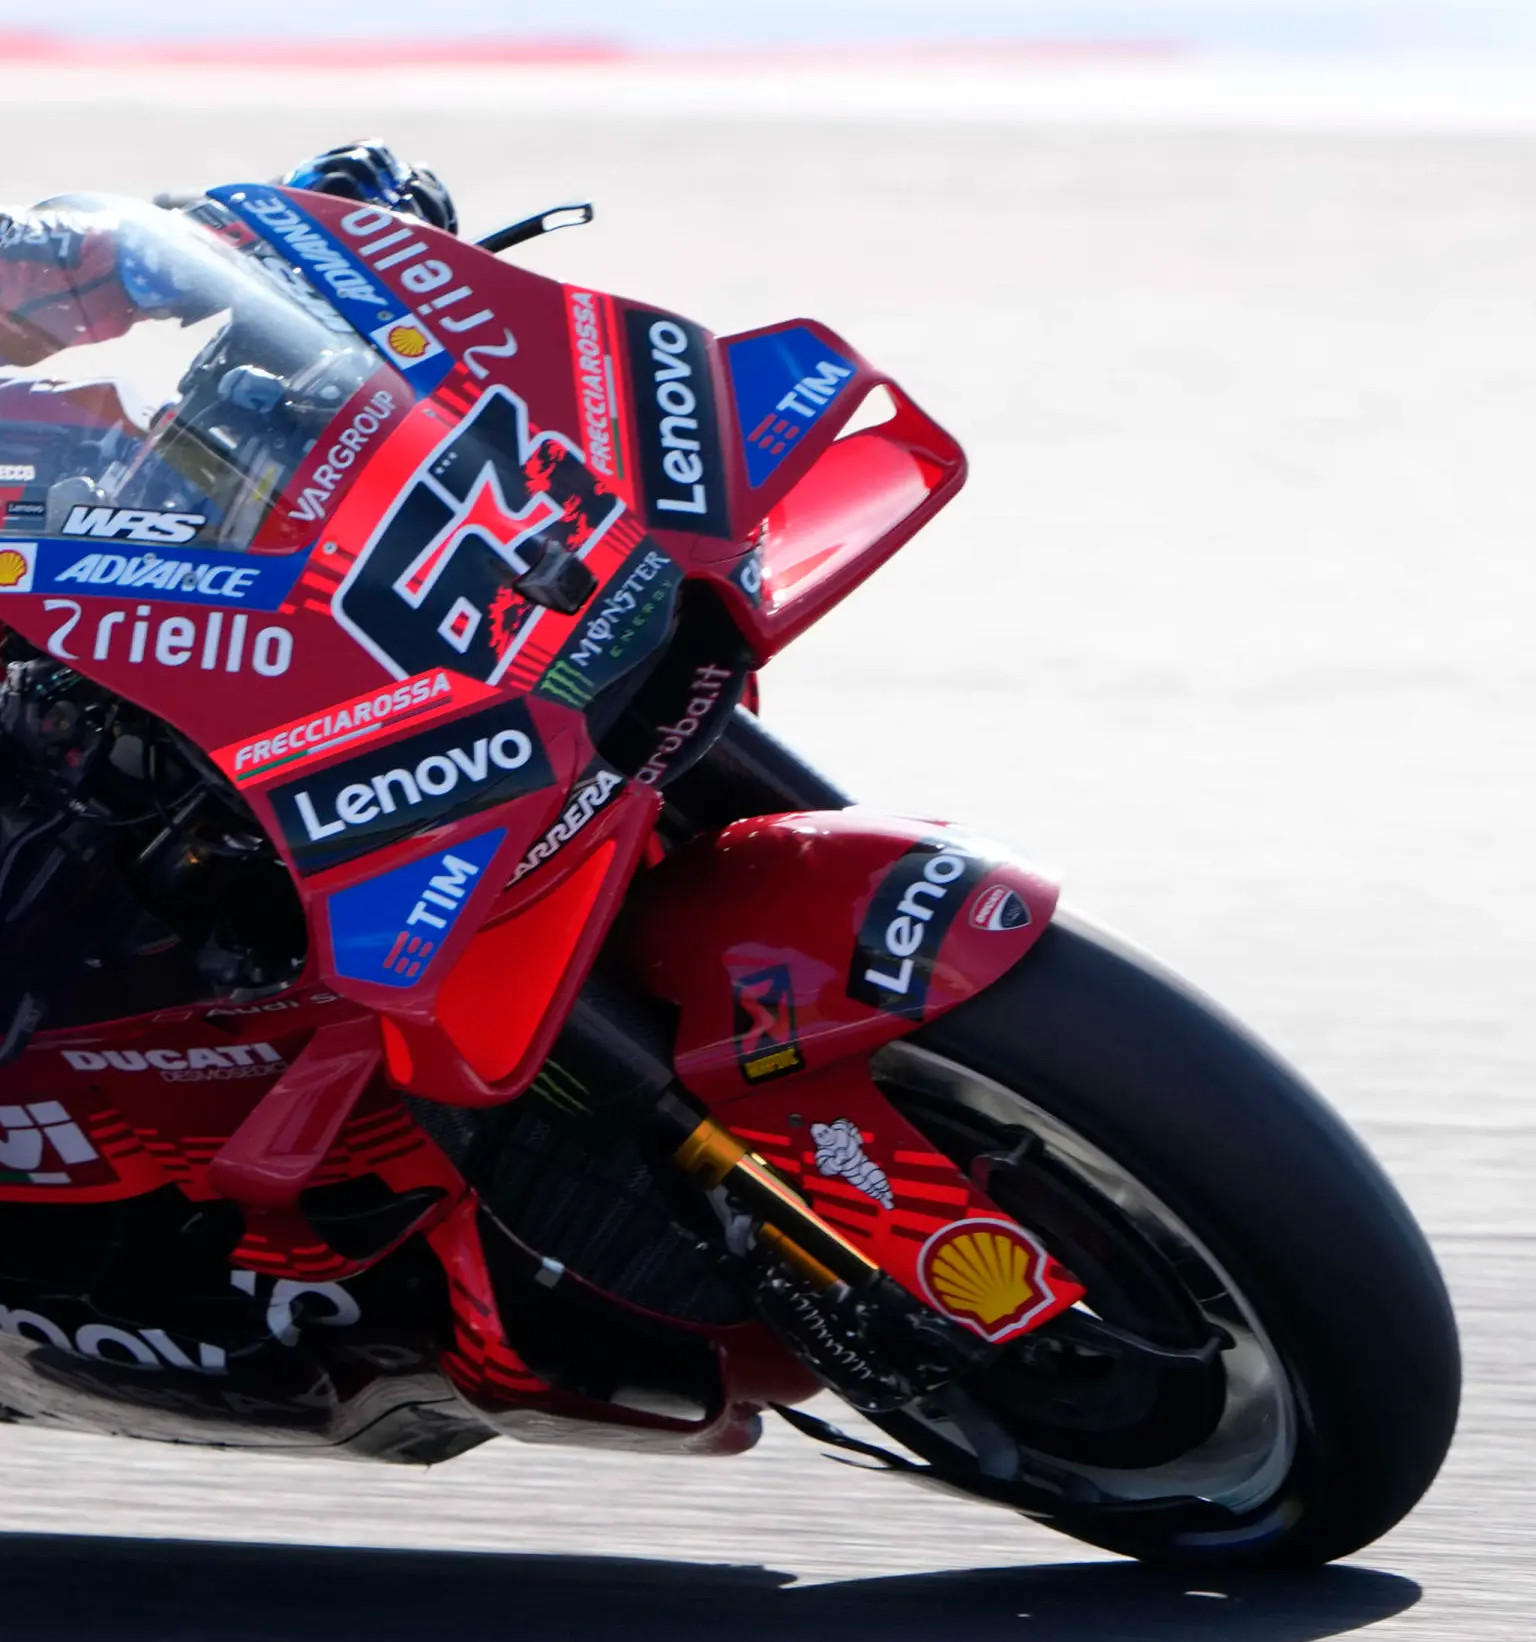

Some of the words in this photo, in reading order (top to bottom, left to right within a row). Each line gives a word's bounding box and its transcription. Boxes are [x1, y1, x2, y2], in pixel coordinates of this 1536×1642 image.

[242, 196, 388, 306] ADVANCE
[570, 292, 614, 476] FRECCIAROSSA
[648, 320, 707, 515] Lenovo
[777, 360, 852, 419] TIM
[288, 389, 398, 524] VARGROUP
[54, 553, 260, 598] ADVANCE
[61, 505, 206, 545] WRS
[330, 384, 628, 687] 63
[92, 605, 294, 677] riello
[569, 550, 671, 668] MONSTER
[234, 673, 453, 770] FRECCIAROSSA
[633, 663, 733, 785] aruba.it
[294, 728, 533, 842] Lenovo
[505, 769, 624, 888] ARRERA
[406, 852, 479, 930] TIM
[865, 847, 966, 995] Leno
[60, 1041, 282, 1072] DUCATI
